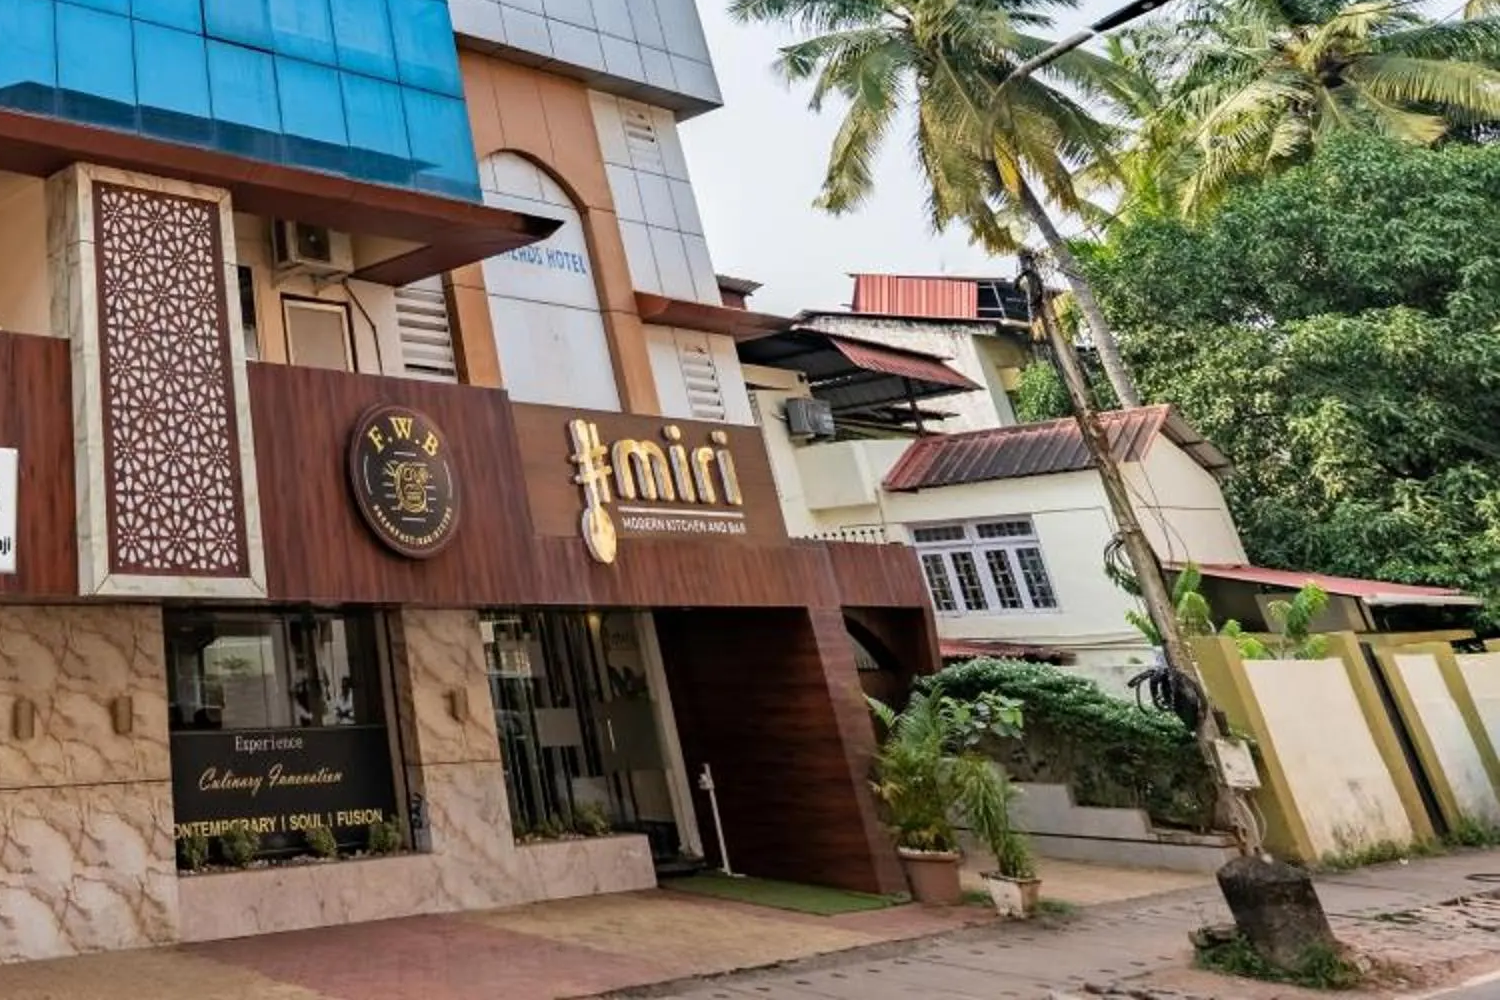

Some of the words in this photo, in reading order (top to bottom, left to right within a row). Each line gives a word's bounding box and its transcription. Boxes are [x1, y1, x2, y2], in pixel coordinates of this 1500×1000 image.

[546, 249, 586, 273] HOTEL
[234, 735, 304, 754] Experience
[198, 766, 264, 797] Culinary
[289, 812, 324, 832] SOUL
[337, 807, 384, 827] FUSION
